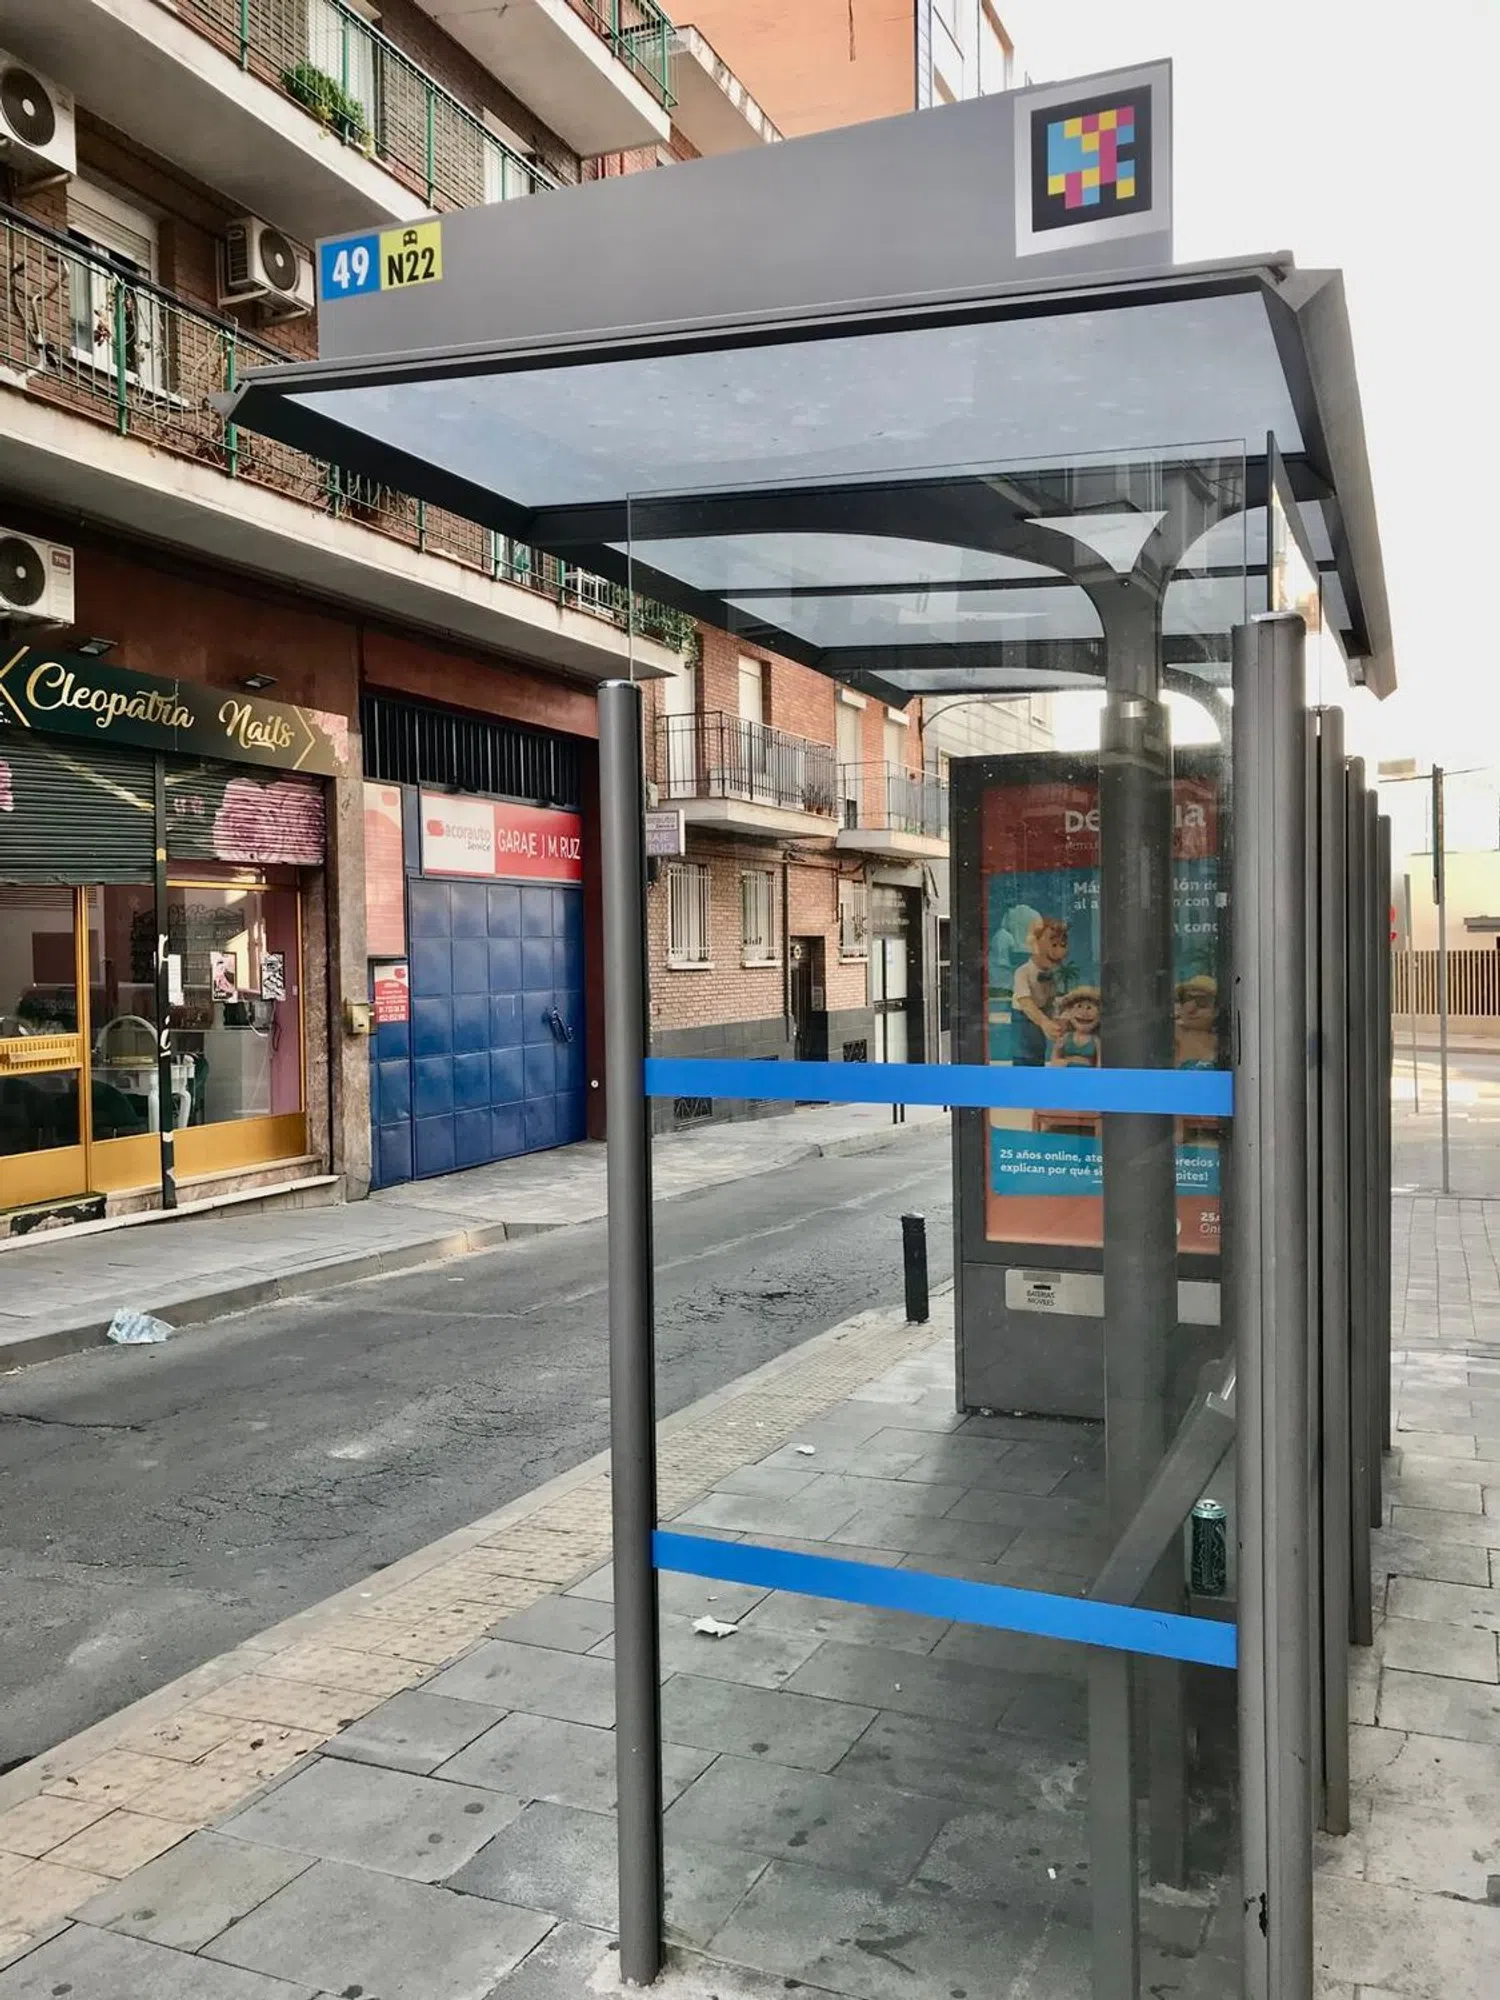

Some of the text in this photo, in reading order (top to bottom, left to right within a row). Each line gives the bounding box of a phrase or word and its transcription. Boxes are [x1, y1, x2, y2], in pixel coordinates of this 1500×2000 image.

[332, 246, 435, 289] 49 N22
[26, 662, 195, 729] Cleopatra
[218, 700, 295, 752] Nails
[446, 823, 491, 841] acorauto
[497, 829, 538, 859] GARAJE
[560, 836, 581, 860] RUIZ
[1000, 1150, 1213, 1168] 25 años online, ate recios
[1000, 1162, 1045, 1175] explican
[1048, 1166, 1066, 1176] por
[1070, 1165, 1091, 1178] qué
[1176, 1170, 1208, 1183] pites!
